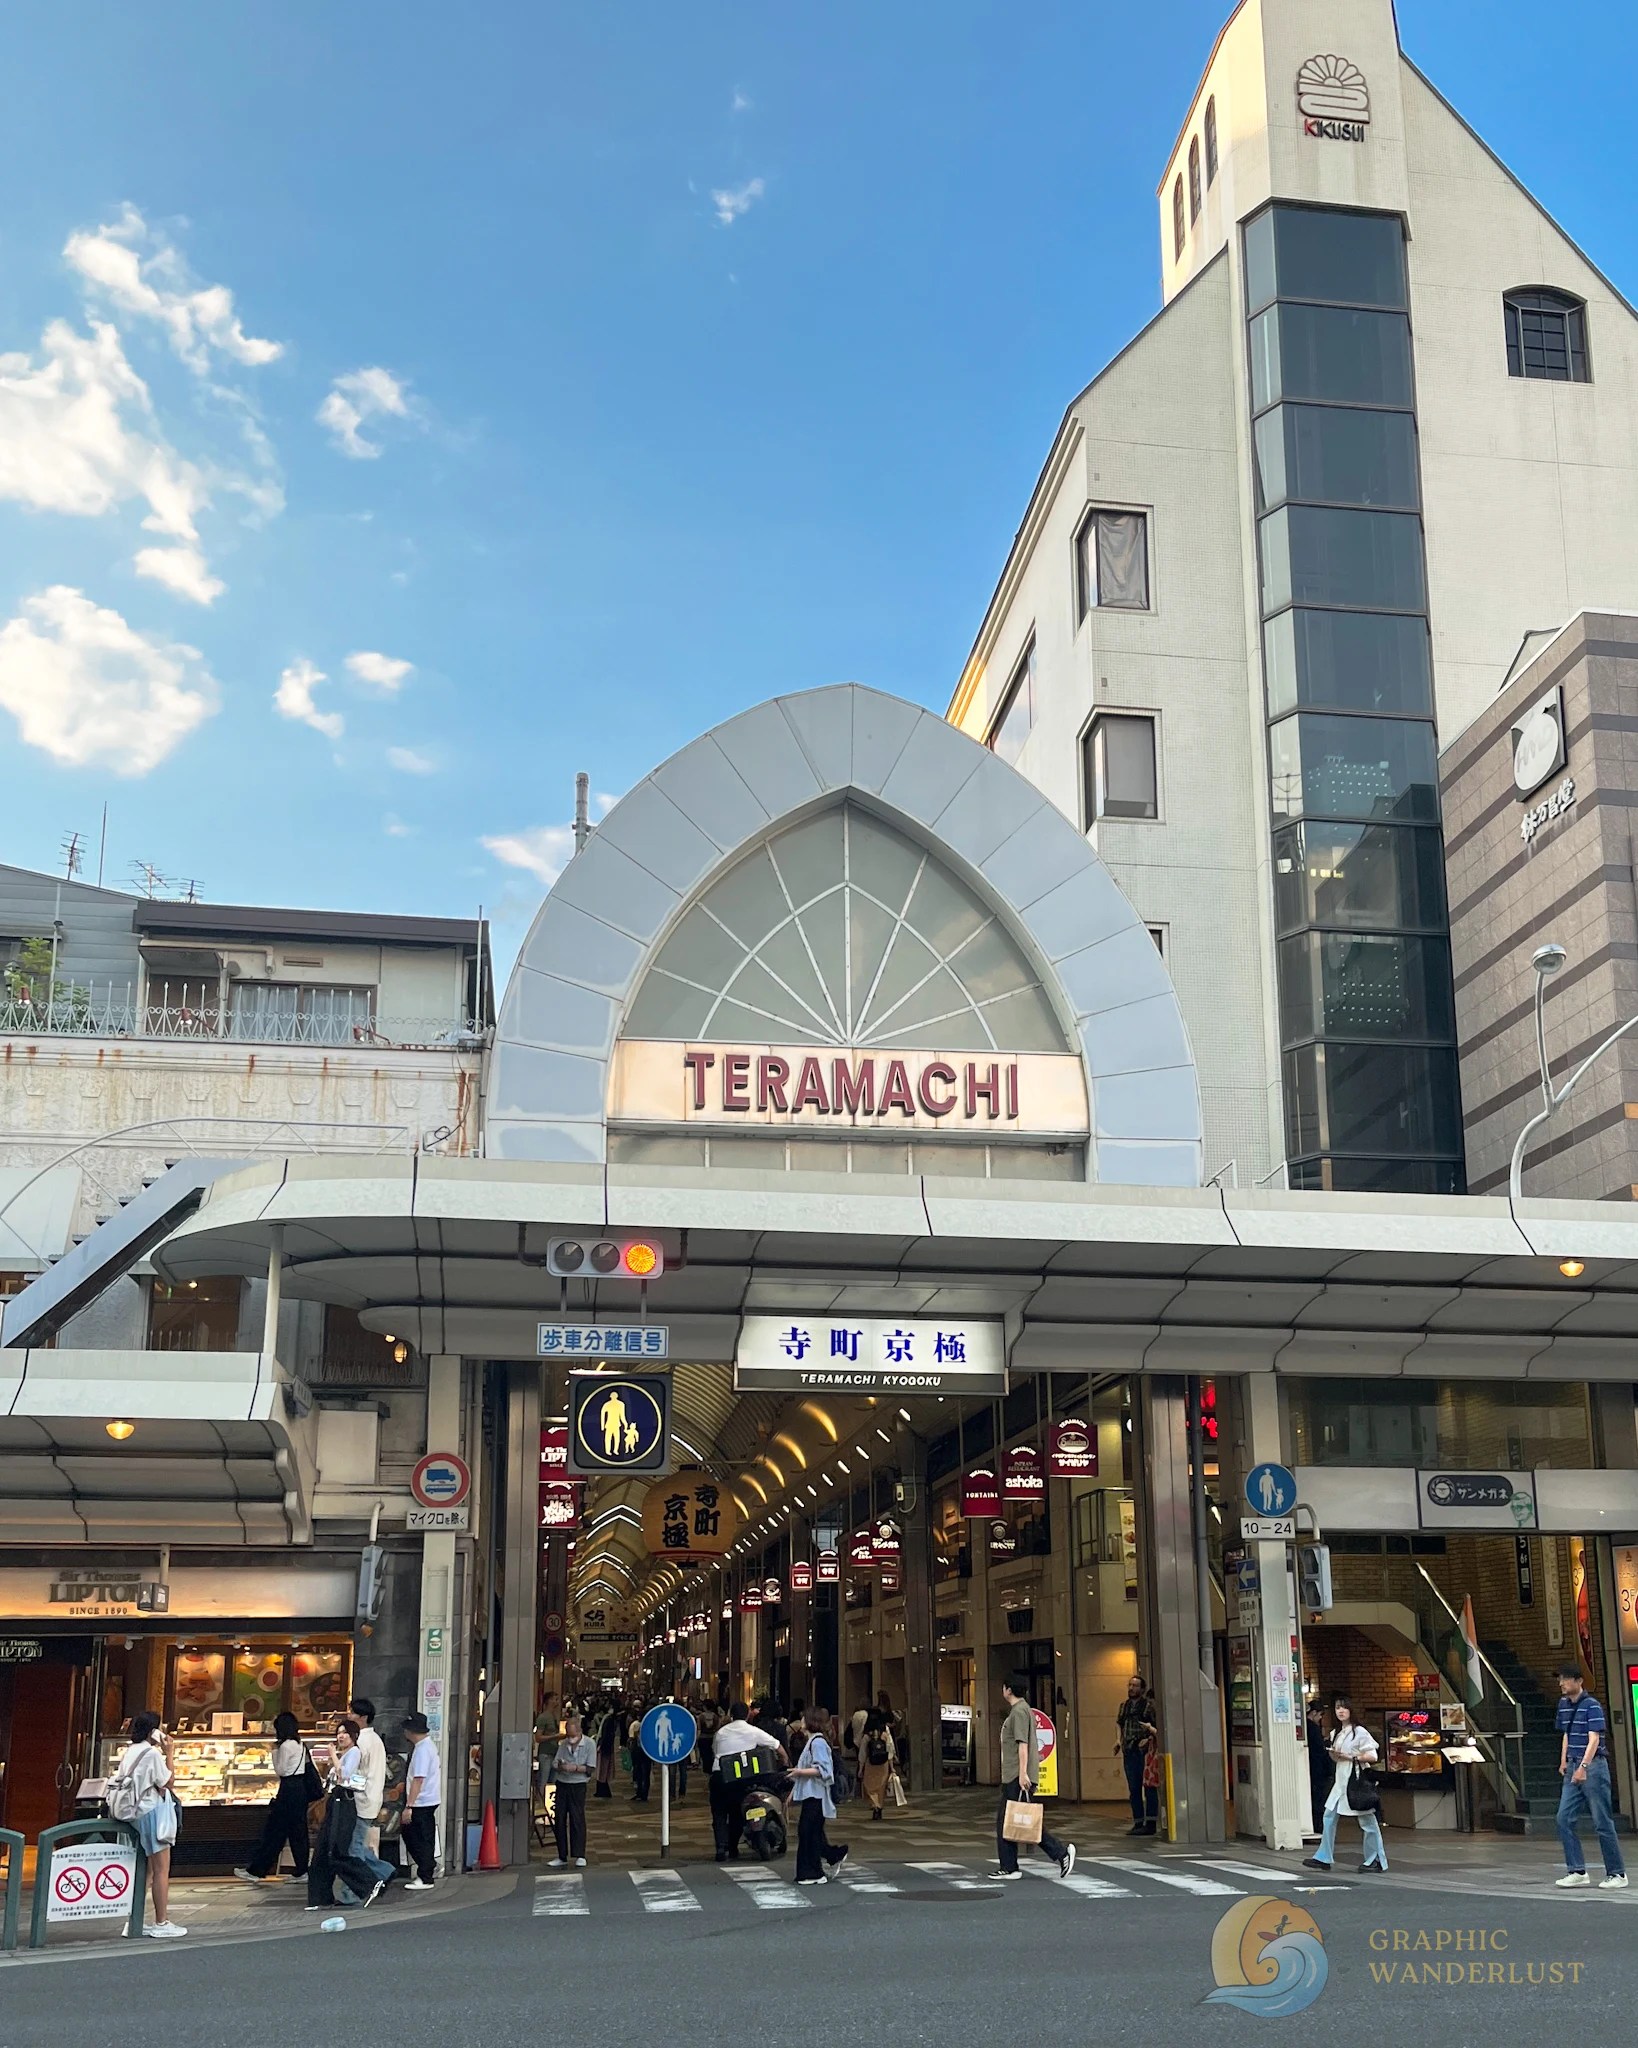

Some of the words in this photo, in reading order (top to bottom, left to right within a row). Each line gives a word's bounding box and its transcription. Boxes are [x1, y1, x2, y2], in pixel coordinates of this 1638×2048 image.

[1304, 118, 1365, 142] KIKUSUI
[685, 1052, 1019, 1120] TERAMACHI
[543, 1329, 662, 1352] 歩車分離信号
[779, 1326, 967, 1364] 寺町京極
[800, 1373, 877, 1385] TERAMACHI
[883, 1375, 942, 1387] KYOGOKU
[1005, 1475, 1044, 1489] ashoka
[1457, 1488, 1509, 1499] サンメガネ
[694, 1484, 720, 1536] 寺町
[410, 1512, 465, 1525] マイクロを除く
[662, 1493, 690, 1548] 京極
[84, 1570, 141, 1581] Thomas
[1621, 1588, 1636, 1611] 3F
[70, 1607, 100, 1615] SINCE
[105, 1607, 128, 1615] 1890
[549, 1618, 560, 1628] 30
[0, 1646, 43, 1658] IPTON
